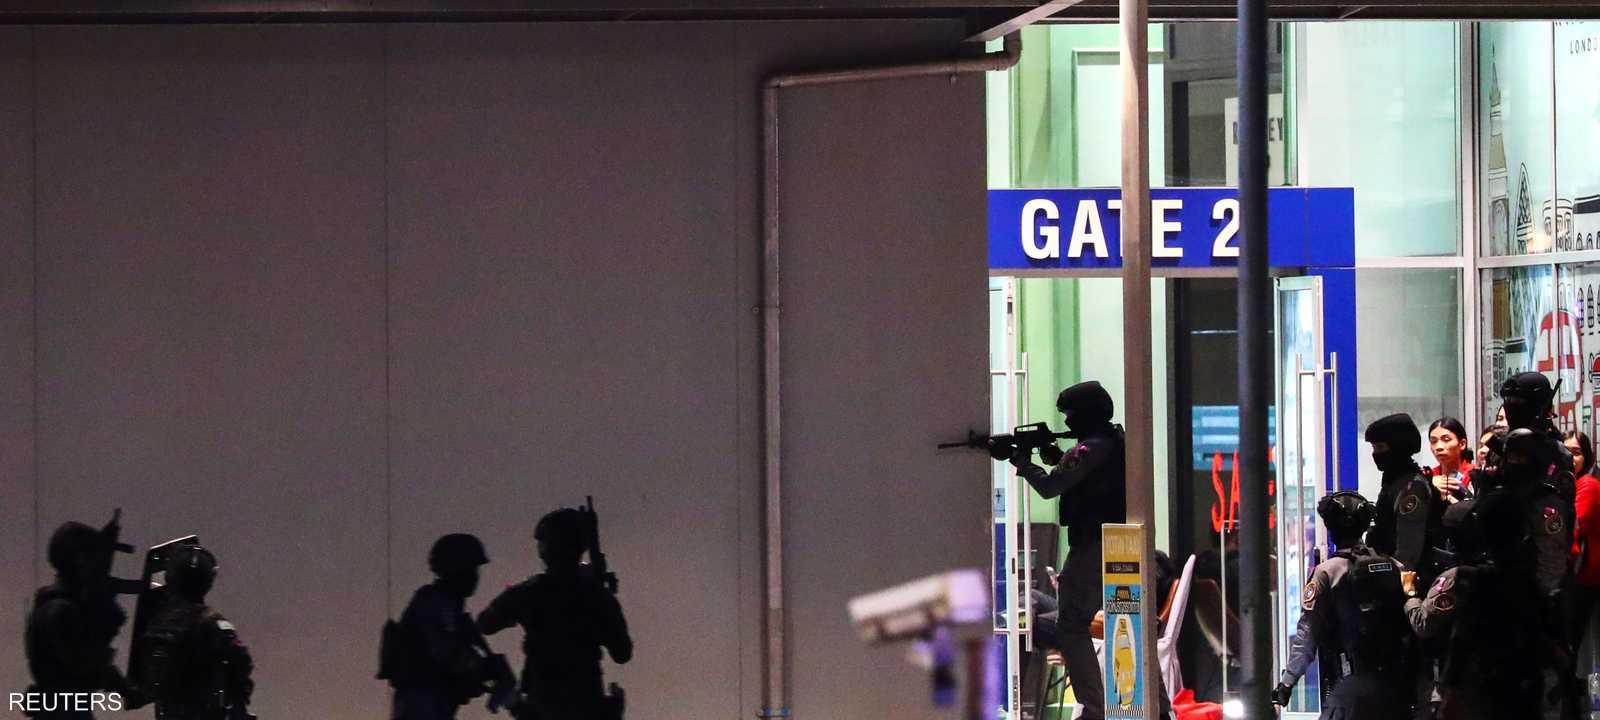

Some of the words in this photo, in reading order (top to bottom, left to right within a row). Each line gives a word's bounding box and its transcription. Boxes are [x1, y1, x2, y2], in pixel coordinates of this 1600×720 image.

[1570, 36, 1600, 54] LONDO
[1211, 198, 1240, 257] 2
[1212, 451, 1275, 533] SA
